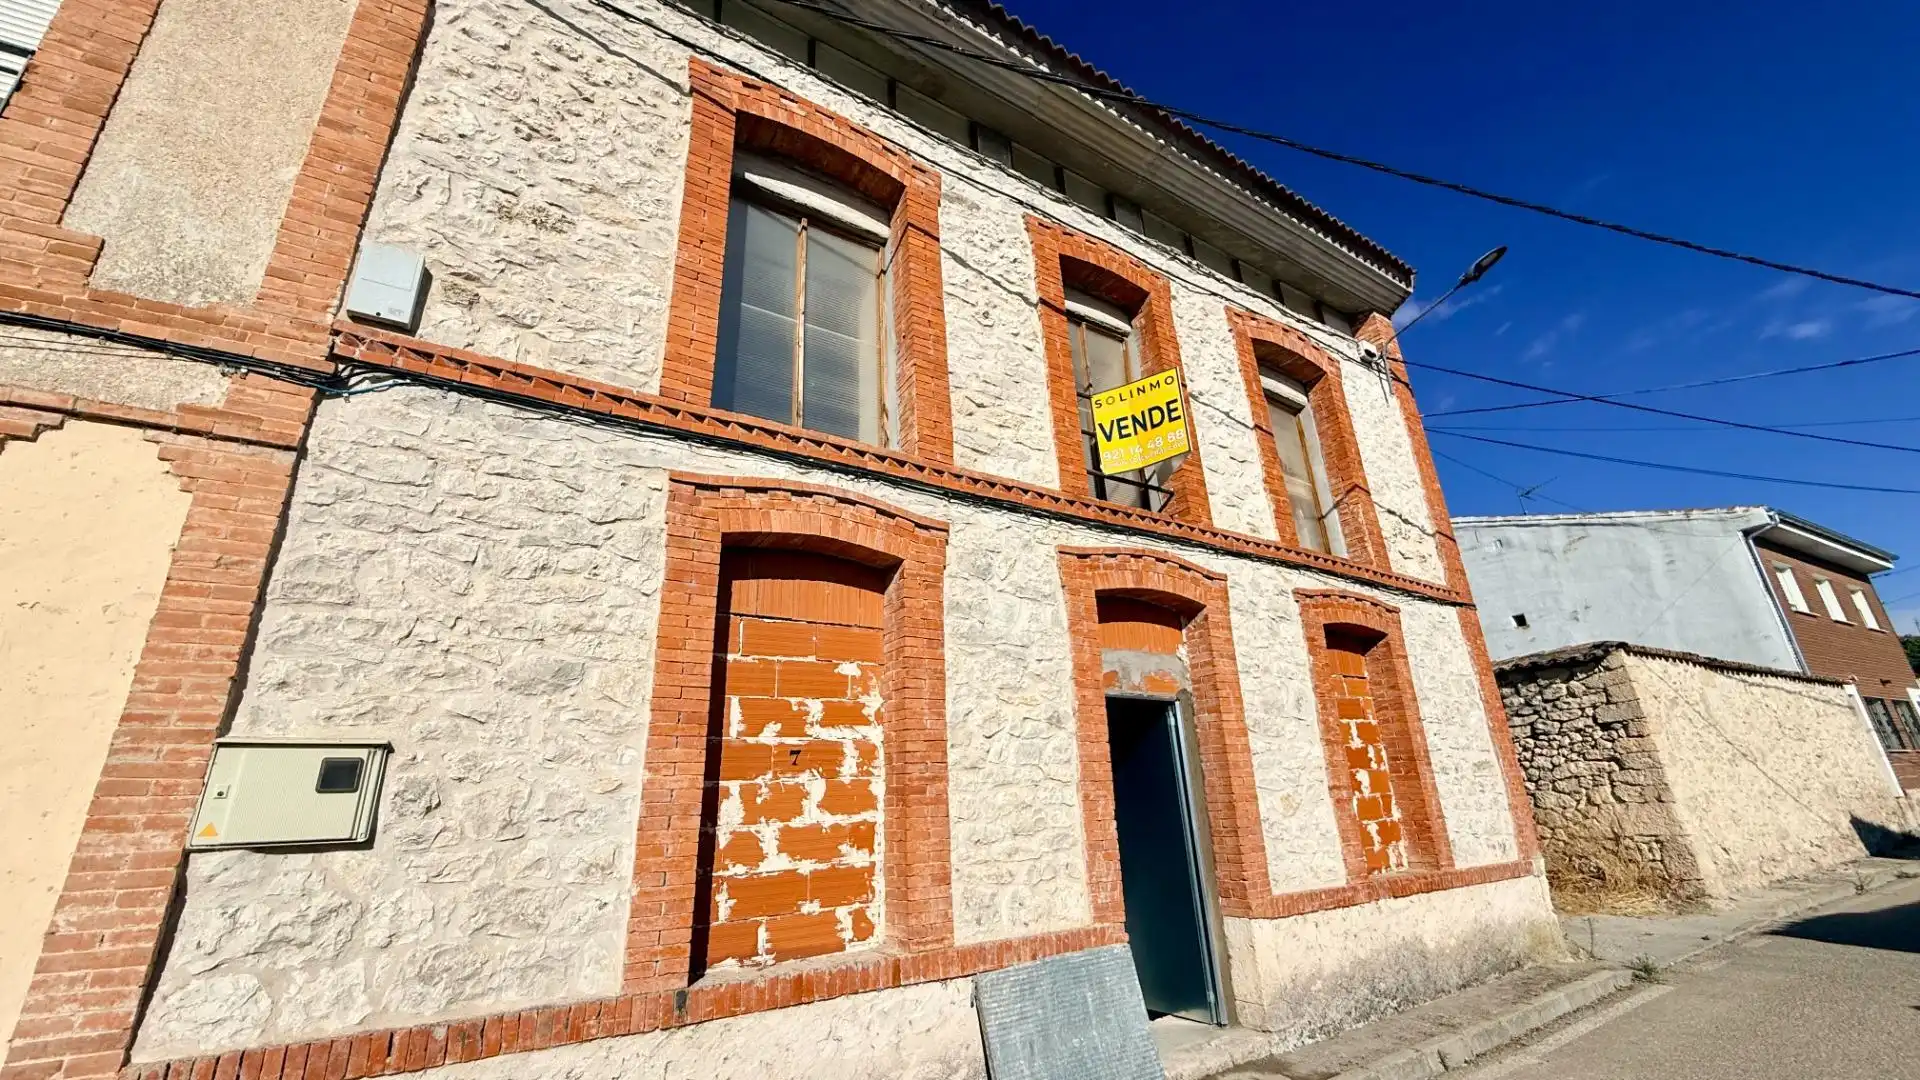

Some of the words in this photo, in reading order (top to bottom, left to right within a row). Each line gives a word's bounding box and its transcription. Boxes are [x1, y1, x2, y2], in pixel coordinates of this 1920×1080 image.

[1095, 376, 1174, 408] SOLINMO
[1098, 399, 1181, 442] VENDE
[1104, 449, 1124, 460] 921
[790, 750, 801, 765] 7
